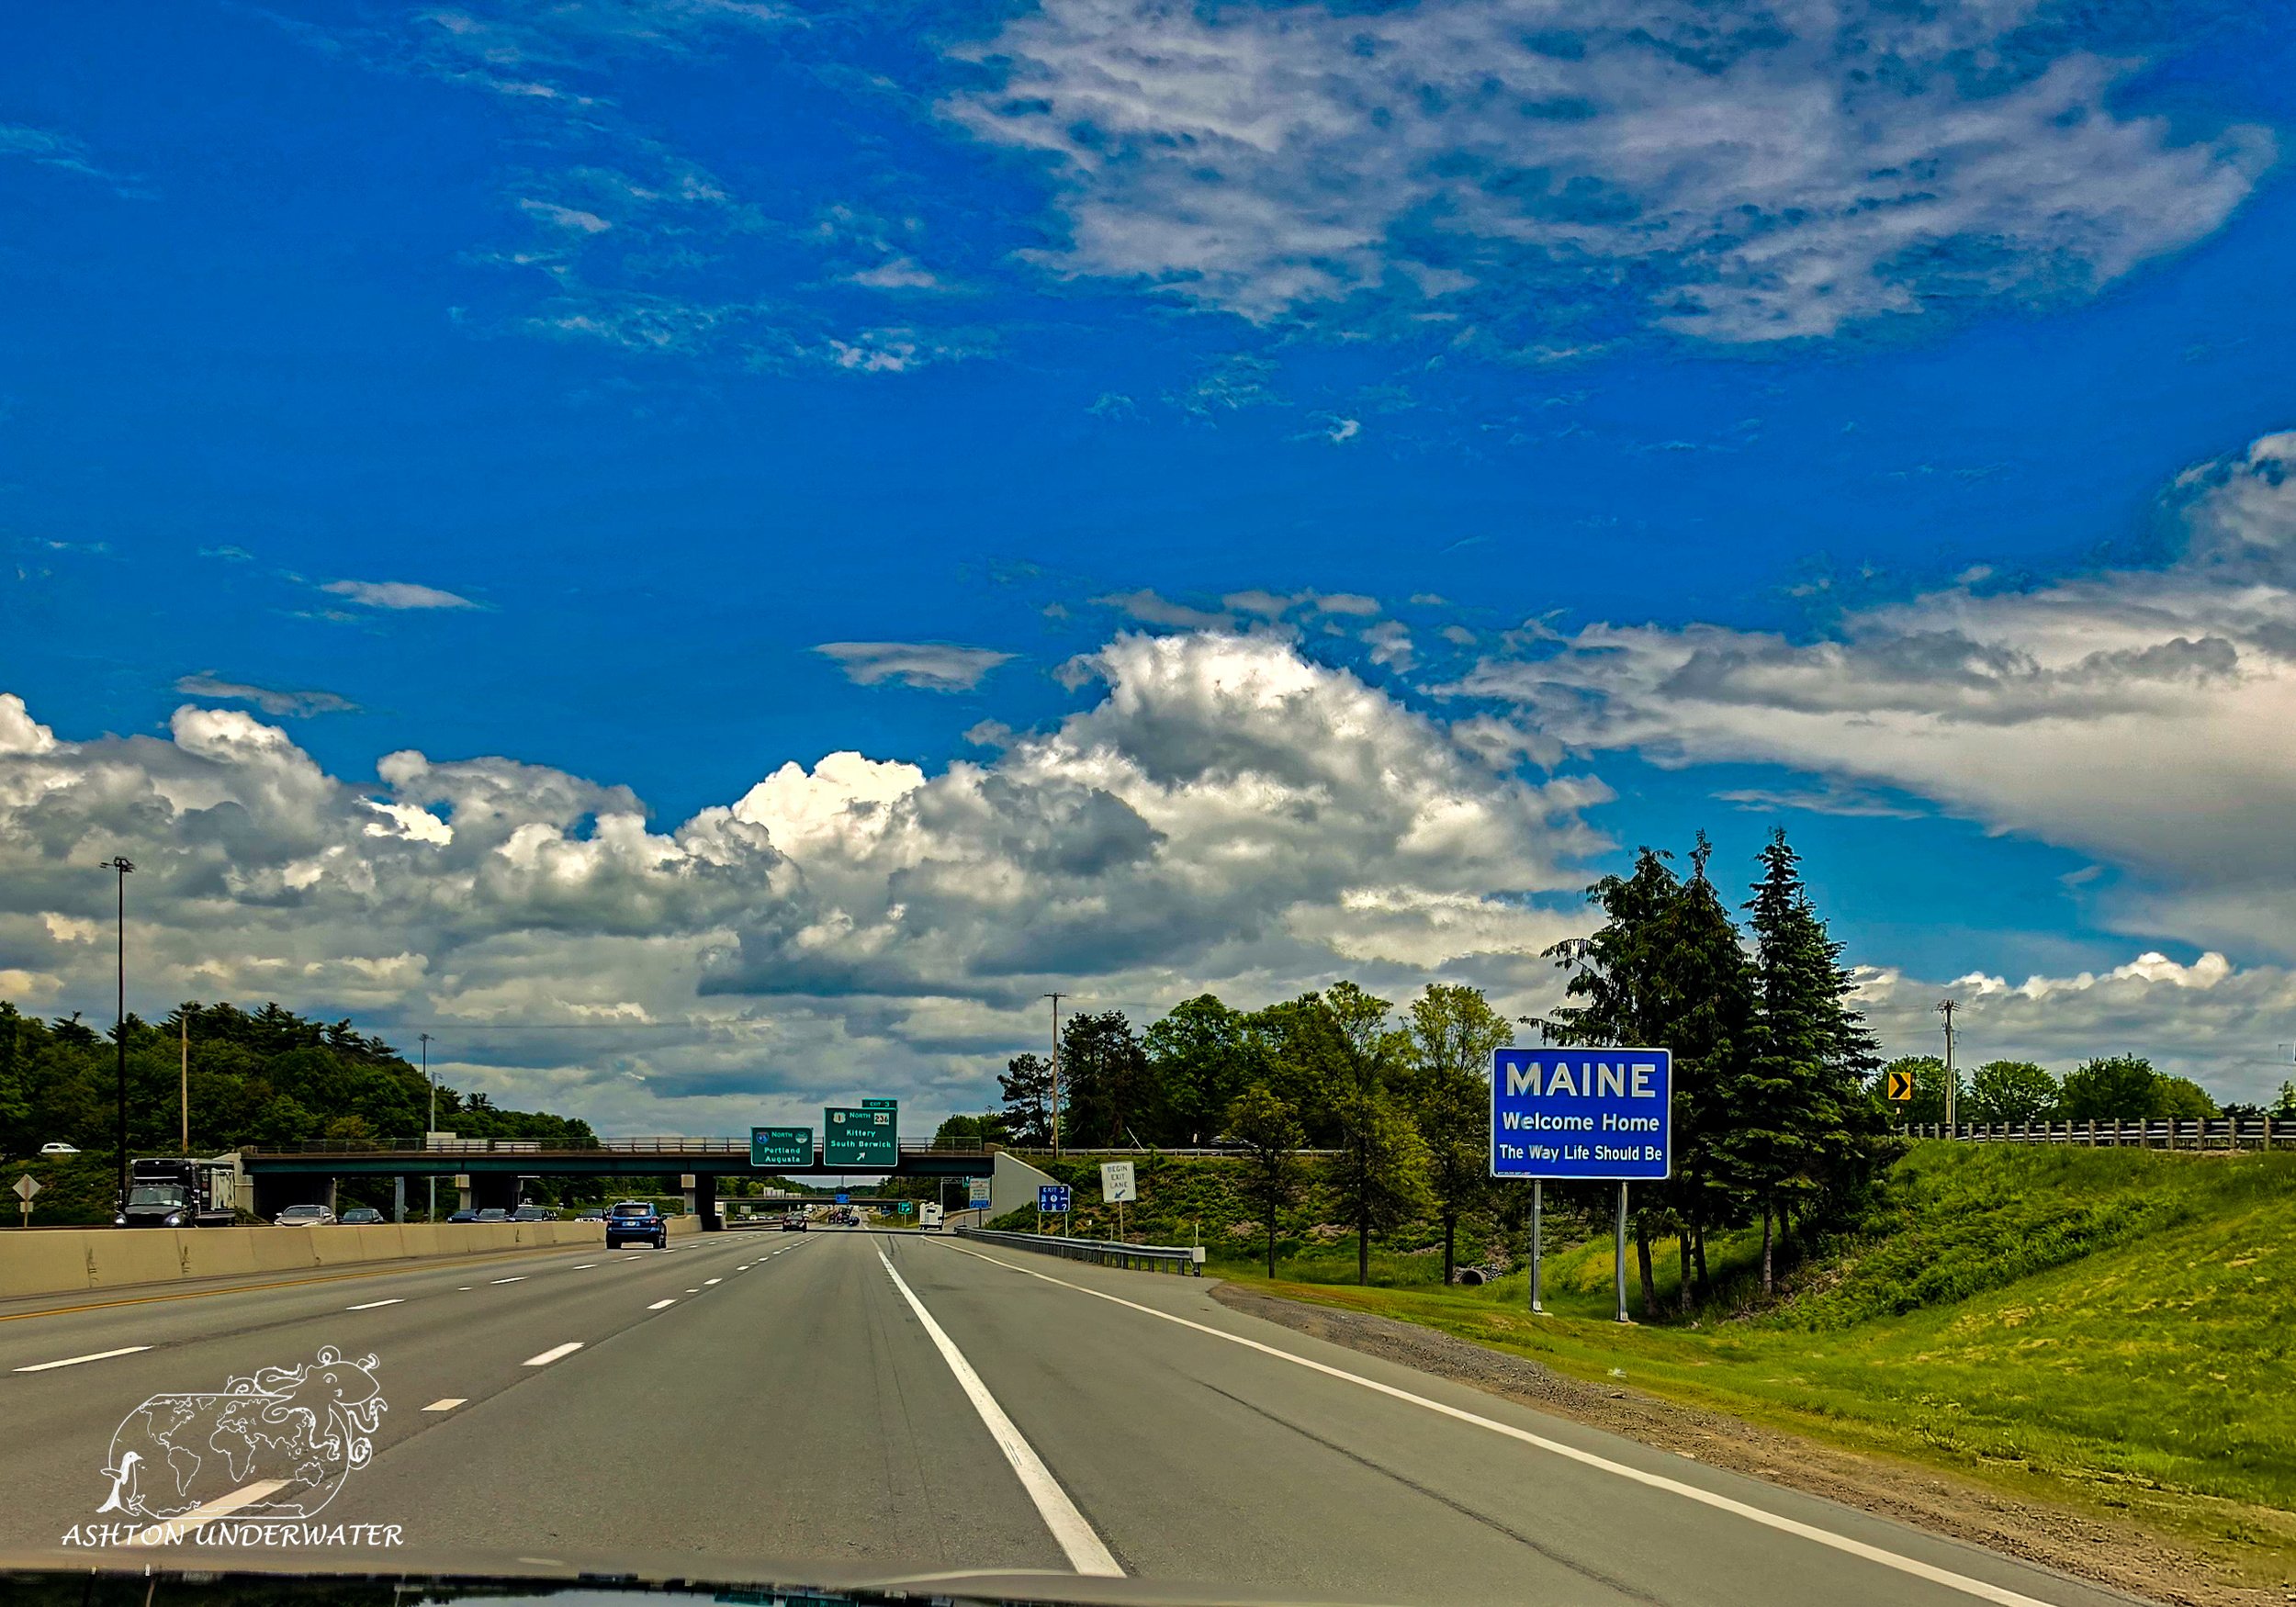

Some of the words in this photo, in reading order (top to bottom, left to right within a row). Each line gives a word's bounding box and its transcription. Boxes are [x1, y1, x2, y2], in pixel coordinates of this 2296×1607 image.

[1506, 1062, 1656, 1097] MAINE
[874, 1115, 889, 1123] 236
[1503, 1111, 1594, 1130] Welcome
[1603, 1113, 1660, 1131] Home
[846, 1129, 876, 1138] Kittery
[830, 1140, 855, 1148] South
[1499, 1144, 1524, 1159] The
[1528, 1144, 1559, 1163] Way
[1564, 1144, 1590, 1160] Life
[1594, 1145, 1639, 1161] Should
[1645, 1146, 1662, 1161] Be
[764, 1155, 801, 1163] Augusta
[1110, 1181, 1128, 1189] LANE
